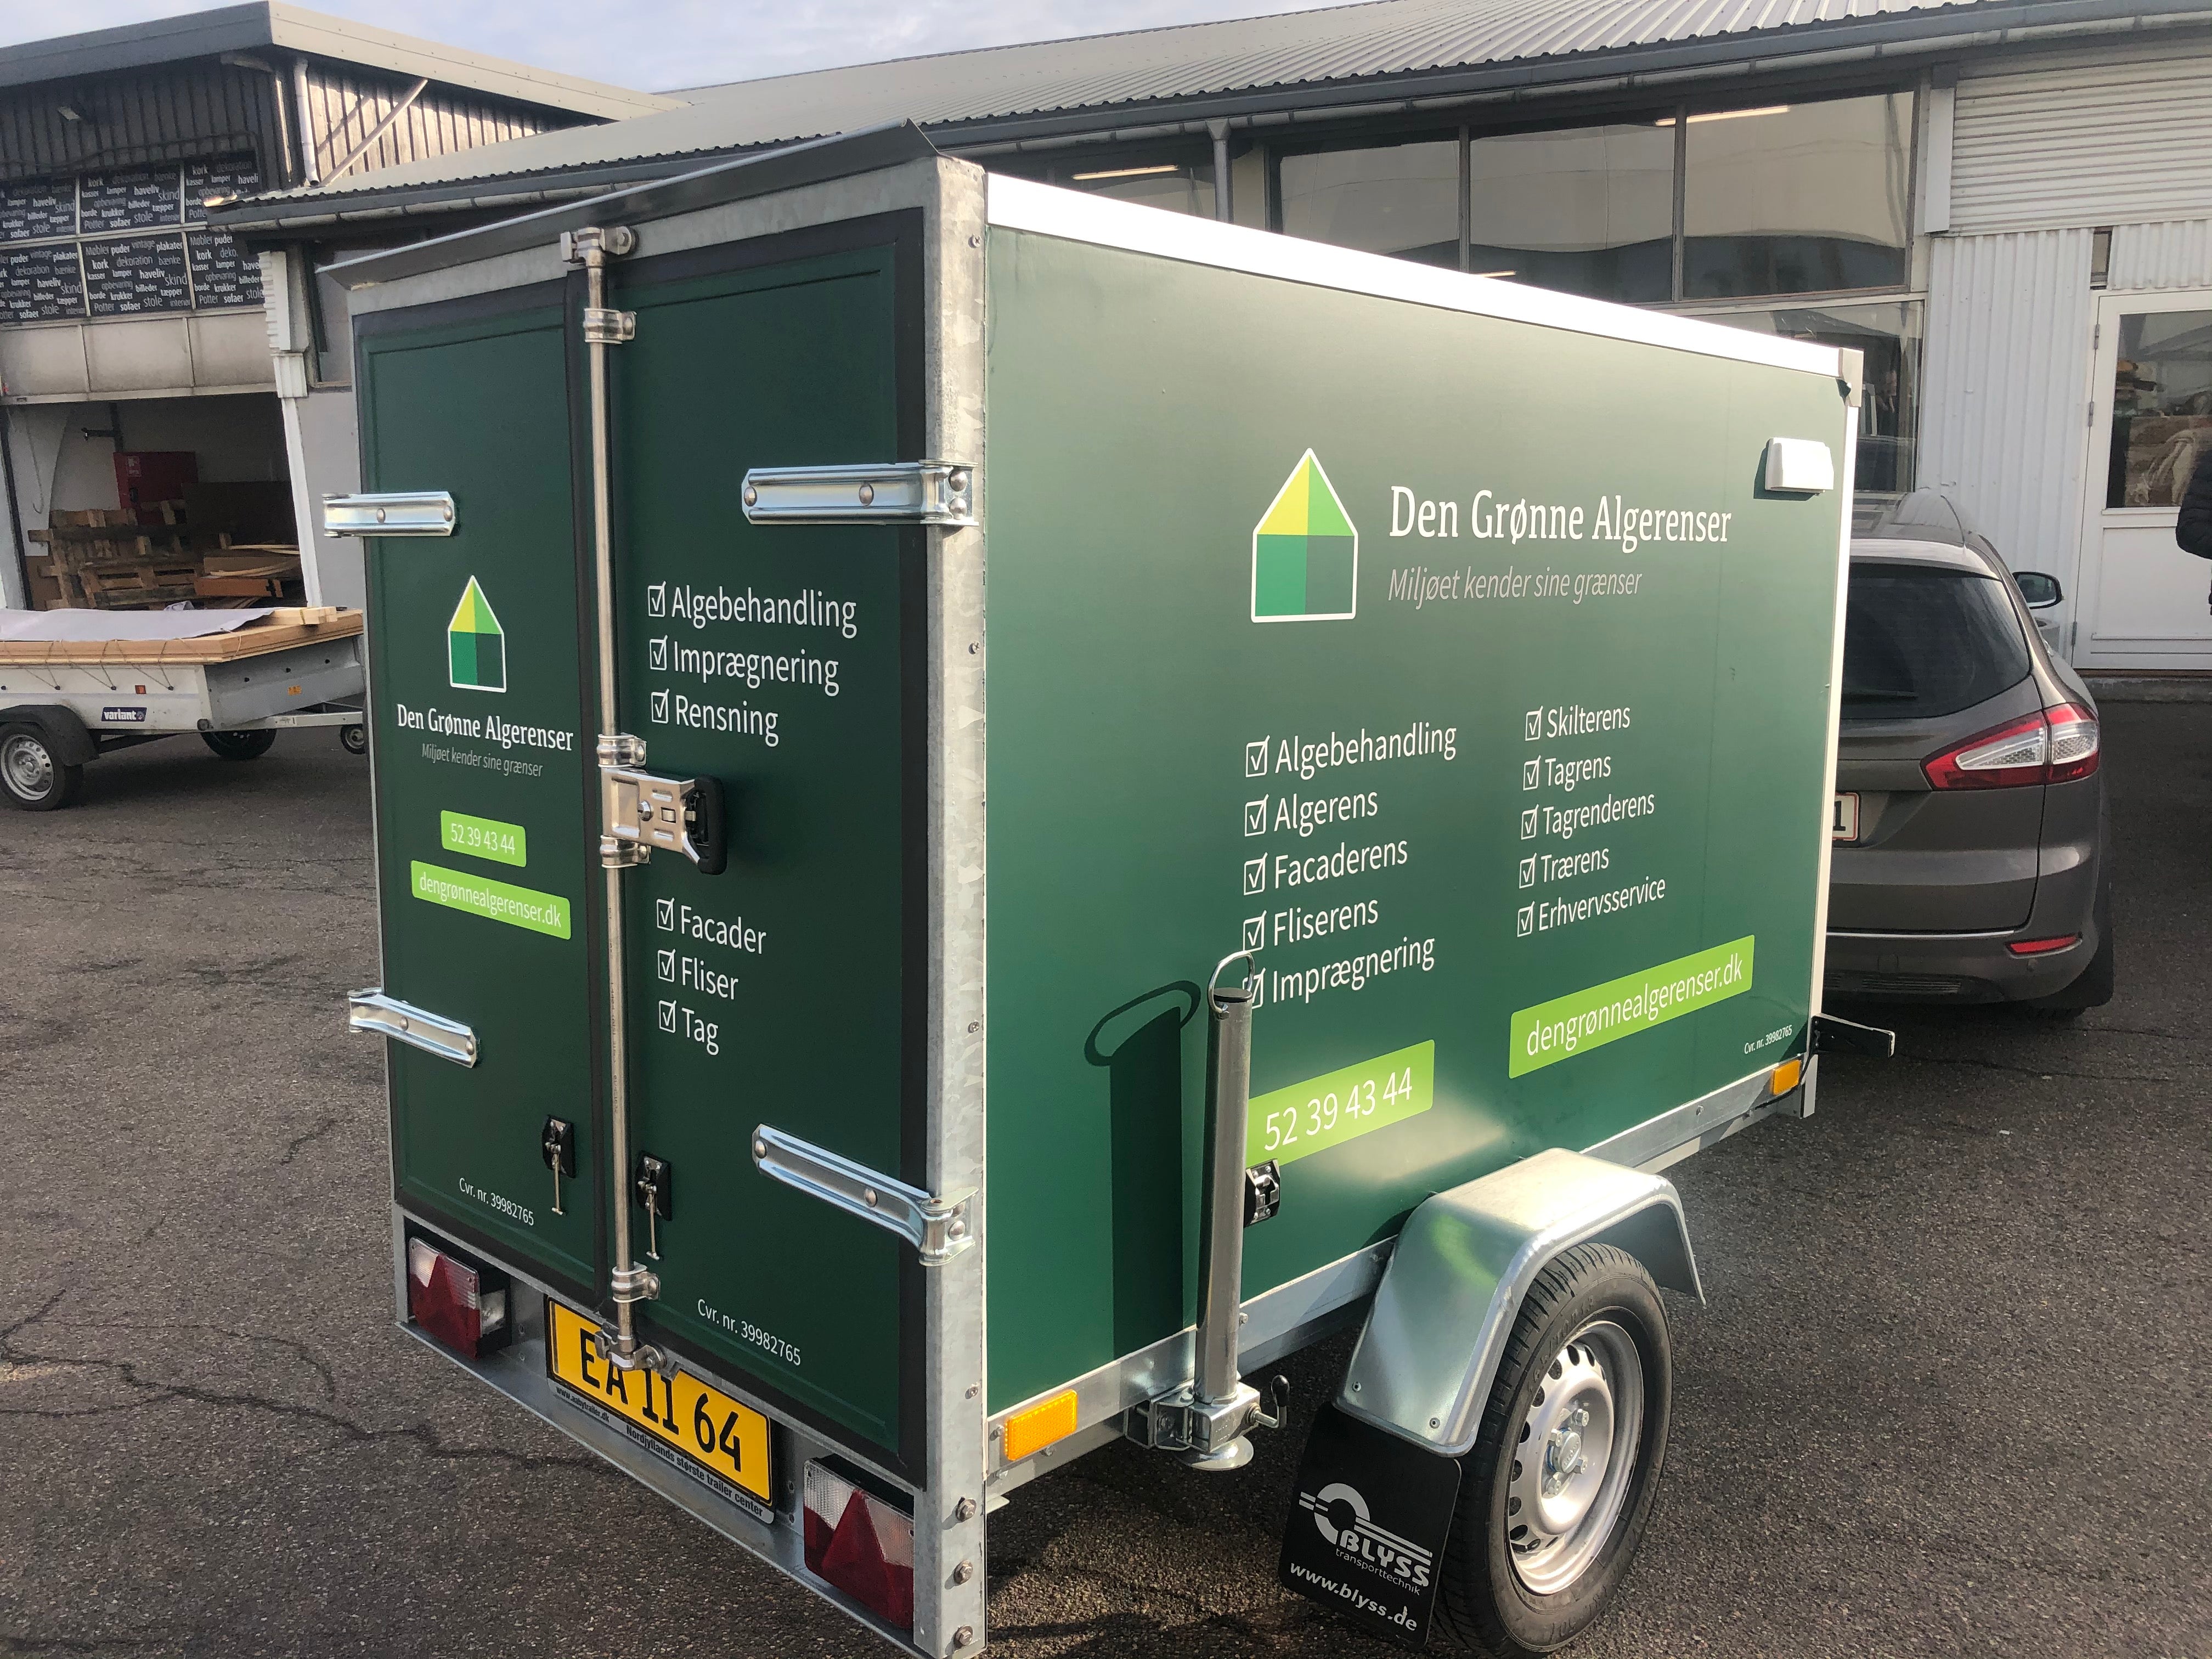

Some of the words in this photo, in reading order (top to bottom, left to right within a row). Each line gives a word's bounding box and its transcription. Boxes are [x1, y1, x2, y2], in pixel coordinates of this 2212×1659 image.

[88, 177, 104, 188] kork
[192, 165, 208, 176] kork
[55, 199, 75, 213] skind
[158, 187, 180, 202] skind
[32, 222, 50, 234] stole
[110, 217, 131, 228] sofaer
[133, 210, 153, 224] stole
[188, 209, 207, 218] Potte
[110, 244, 130, 256] puder
[156, 241, 183, 253] plakater
[189, 234, 212, 246] Møbler
[196, 249, 212, 261] kork
[10, 253, 29, 266] puder
[53, 251, 78, 263] plakater
[15, 265, 50, 276] dekoration
[87, 272, 105, 280] kasser
[111, 269, 132, 278] lamper
[139, 268, 165, 279] haveliv
[92, 258, 109, 270] kork
[116, 255, 153, 268] dekoration
[158, 255, 181, 266] bænke
[191, 263, 209, 272] kasser
[216, 260, 235, 269] lamper
[242, 260, 259, 270] have
[37, 277, 61, 288] haveliv
[60, 281, 82, 295] skind
[89, 291, 106, 300] borde
[110, 291, 133, 301] krukker
[160, 288, 182, 297] tæpper
[135, 284, 157, 293] billeder
[165, 272, 188, 286] skind
[194, 283, 210, 291] borde
[214, 283, 236, 292] krukker
[239, 275, 260, 284] billeder
[0, 310, 14, 320] otter
[19, 309, 39, 319] sofaer
[41, 303, 60, 315] stole
[9, 299, 31, 309] krukker
[94, 302, 115, 312] Potter
[120, 301, 141, 312] sofaer
[144, 295, 163, 307] stole
[199, 294, 218, 304] Potter
[223, 293, 243, 303] sofaer
[1389, 486, 1458, 538] Den
[1471, 489, 1584, 545] Grønne
[1591, 494, 1731, 554] Algerenser
[1388, 566, 1460, 610] Miljøet
[1463, 566, 1531, 599] kender
[1534, 566, 1571, 598] sine
[1573, 571, 1643, 605] grænser
[672, 584, 857, 639] Algebehandling
[674, 641, 839, 697] Imprægnering
[104, 708, 137, 720] variant
[397, 704, 424, 730] Den
[428, 708, 481, 737] Grønne
[486, 715, 574, 751] Algerenser
[675, 695, 779, 747] Rensning
[1546, 704, 1630, 738] Skilterens
[422, 743, 450, 764] Miljøet
[452, 747, 482, 767] kender
[483, 753, 501, 770] sine
[504, 759, 543, 777] grænser
[1274, 721, 1457, 780] Algebehandling
[1545, 755, 1611, 792] Tagrens
[1274, 791, 1378, 837] Algerens
[1543, 793, 1655, 839] Tagrenderens
[450, 823, 465, 844] 52
[467, 827, 481, 847] 39
[484, 831, 498, 851] 43
[500, 834, 515, 855] 44
[1274, 839, 1408, 889] Facaderens
[1541, 847, 1610, 883] Trærens
[420, 872, 561, 928] dengrønnealgerenser.dk
[1539, 876, 1666, 932] Erhvervsservice
[681, 905, 767, 955] Facader
[1273, 899, 1378, 946] Fliserens
[682, 957, 739, 1000] Fliser
[1273, 936, 1435, 1004] Imprægnering
[1527, 952, 1743, 1056] dengrønnealgerenser.dk
[681, 1007, 719, 1056] Tag
[1744, 1042, 1756, 1054] Cvr.
[1756, 1039, 1764, 1050] nr.
[1765, 1024, 1792, 1046] 39982765
[1264, 1107, 1298, 1152] 52
[1306, 1093, 1338, 1136] 39
[1345, 1080, 1376, 1119] 43
[1383, 1066, 1413, 1106] 44
[459, 1177, 476, 1198] Cvr.
[477, 1189, 489, 1204] nr.
[490, 1192, 534, 1226] 39982765
[698, 1299, 720, 1324] Cvr.
[723, 1314, 738, 1334] nr.
[741, 1321, 801, 1366] 39982765
[580, 1328, 628, 1404] EA
[642, 1368, 679, 1435] 11
[694, 1393, 741, 1472] 64
[626, 1425, 675, 1462] Nordjyllands
[676, 1456, 704, 1480] største
[707, 1474, 732, 1498] trailer
[735, 1493, 763, 1517] center
[1336, 1548, 1420, 1596] transporttechnik
[1340, 1529, 1430, 1587] BLYSS
[1290, 1562, 1417, 1631] www.blyss.de
